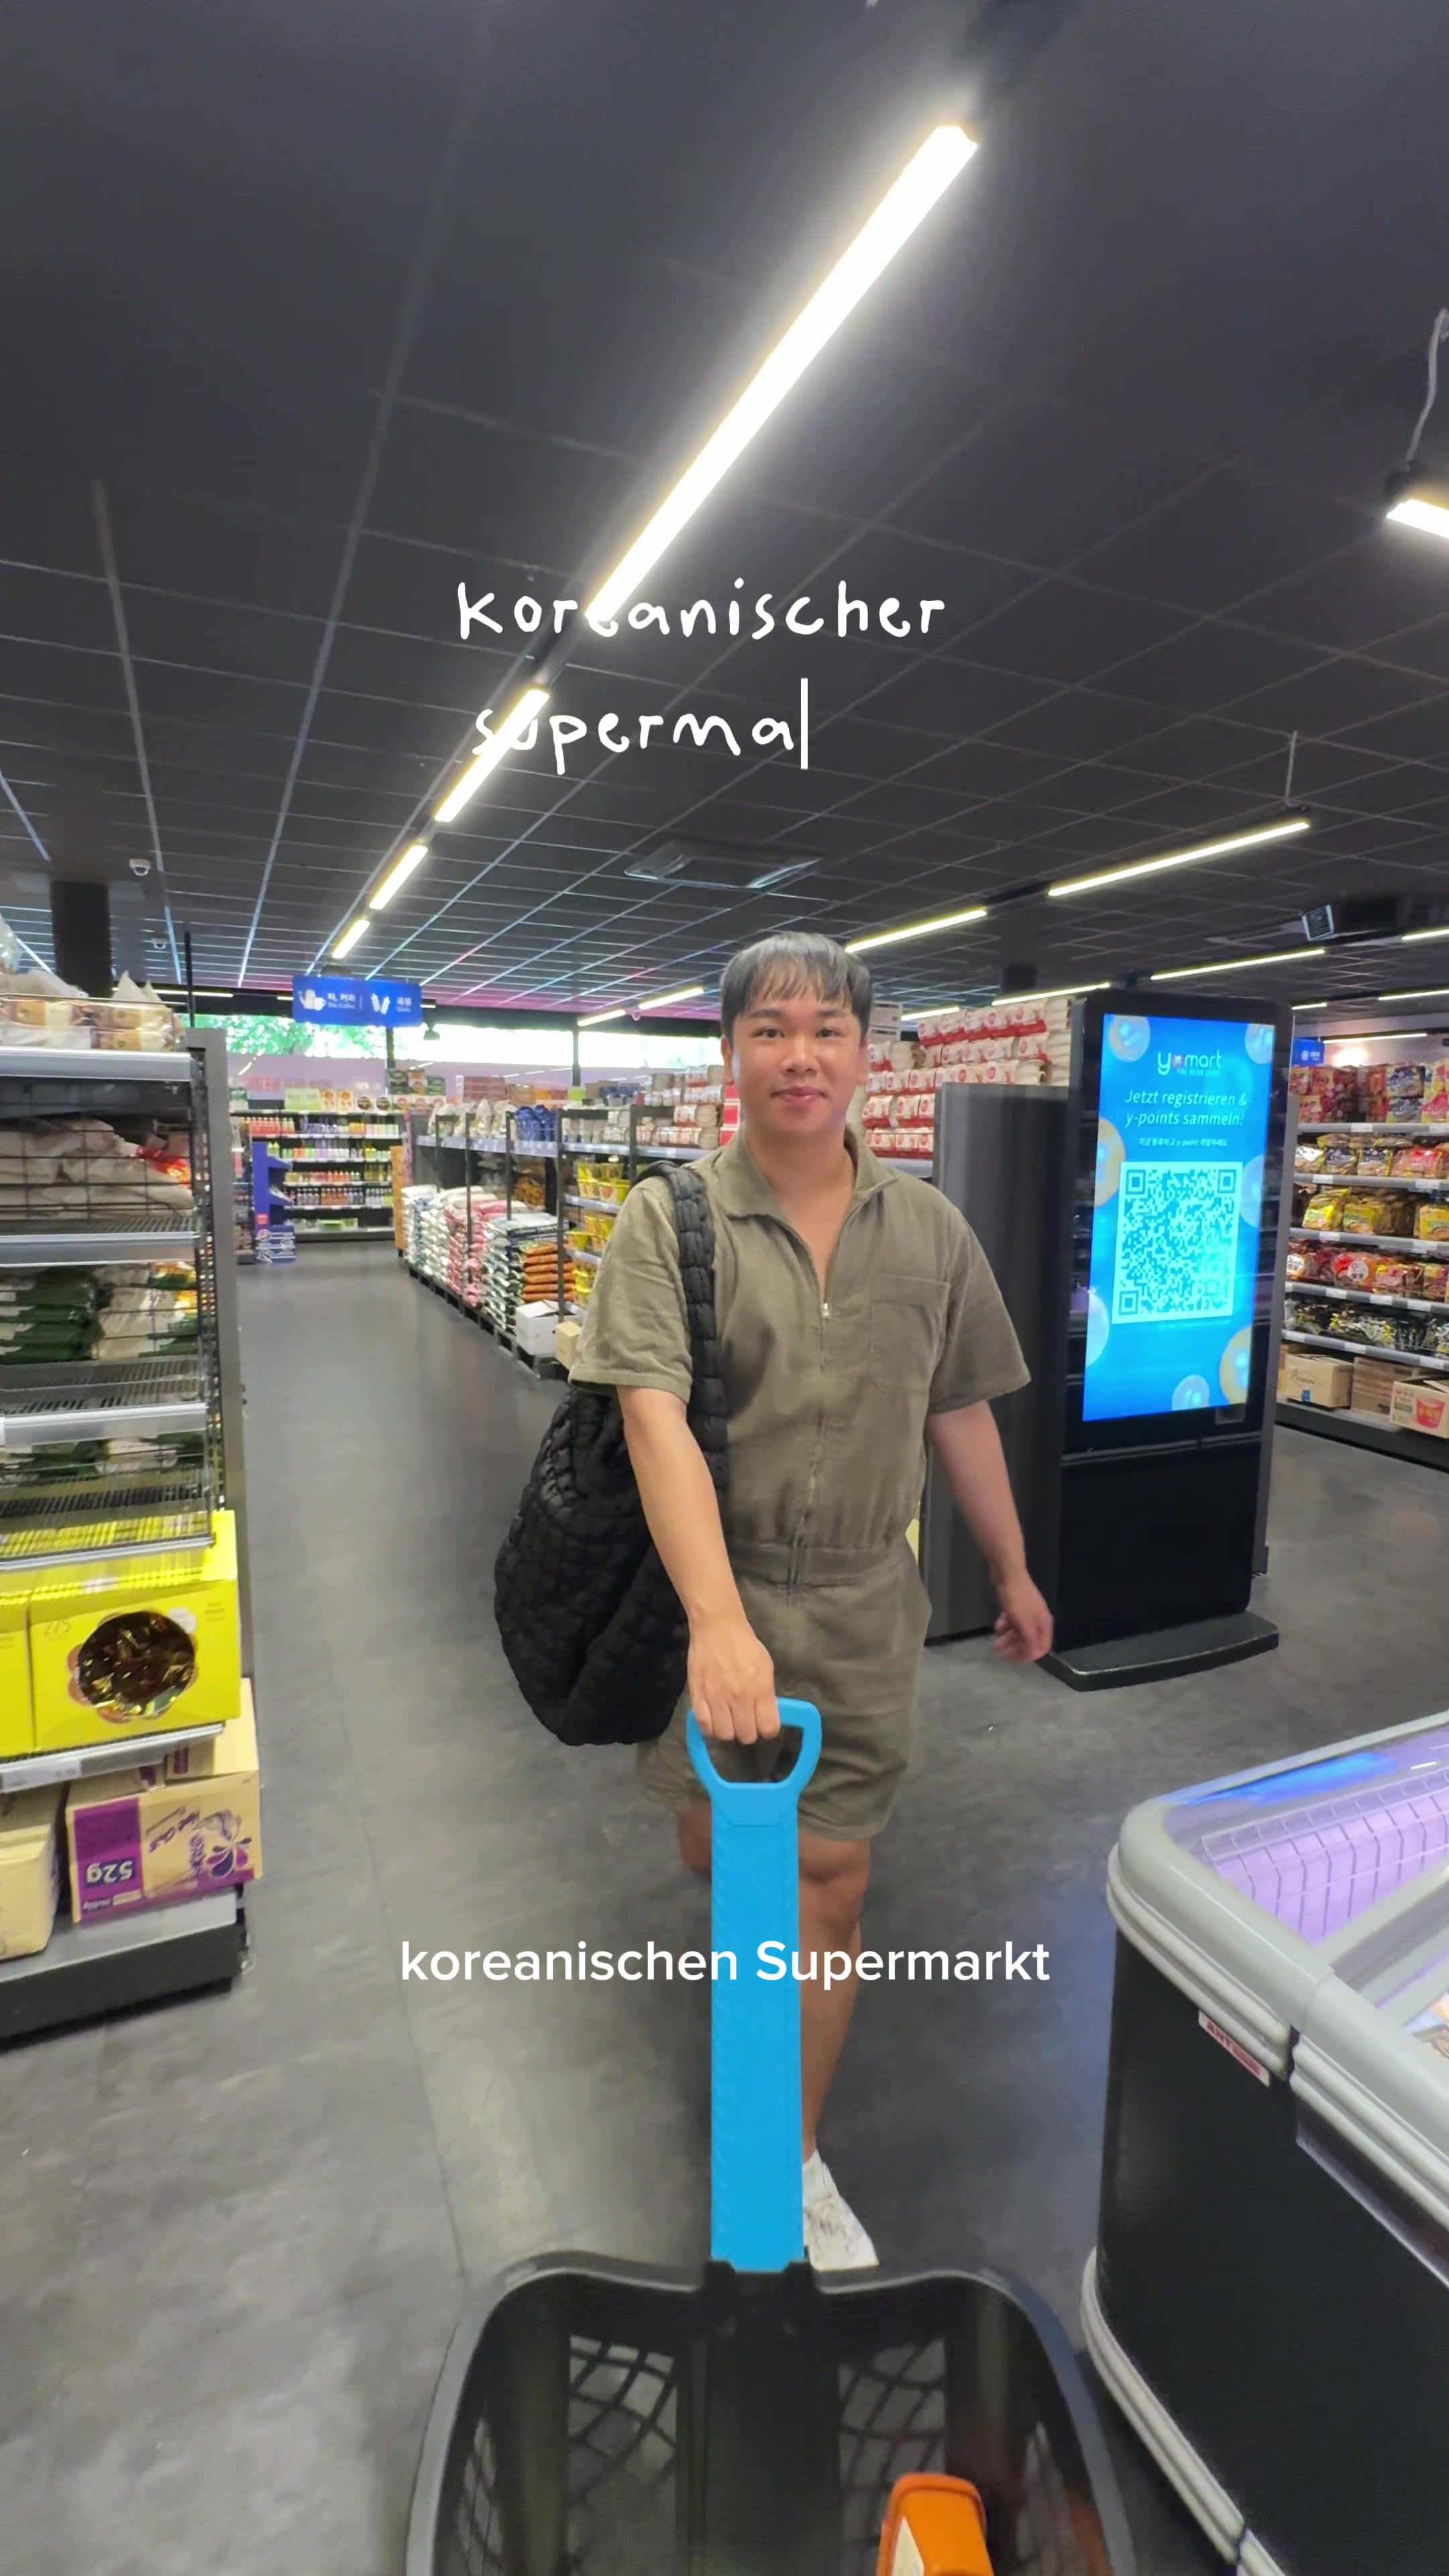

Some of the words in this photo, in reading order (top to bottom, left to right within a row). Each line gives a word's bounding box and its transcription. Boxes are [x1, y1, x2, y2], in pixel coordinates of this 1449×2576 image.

[1125, 1089, 1159, 1104] Jetzt
[1161, 1089, 1236, 1109] registrieren
[1238, 1091, 1247, 1106] &
[1125, 1110, 1179, 1128] y-points
[1182, 1111, 1246, 1126] sammeln!
[87, 1861, 133, 1884] 52g
